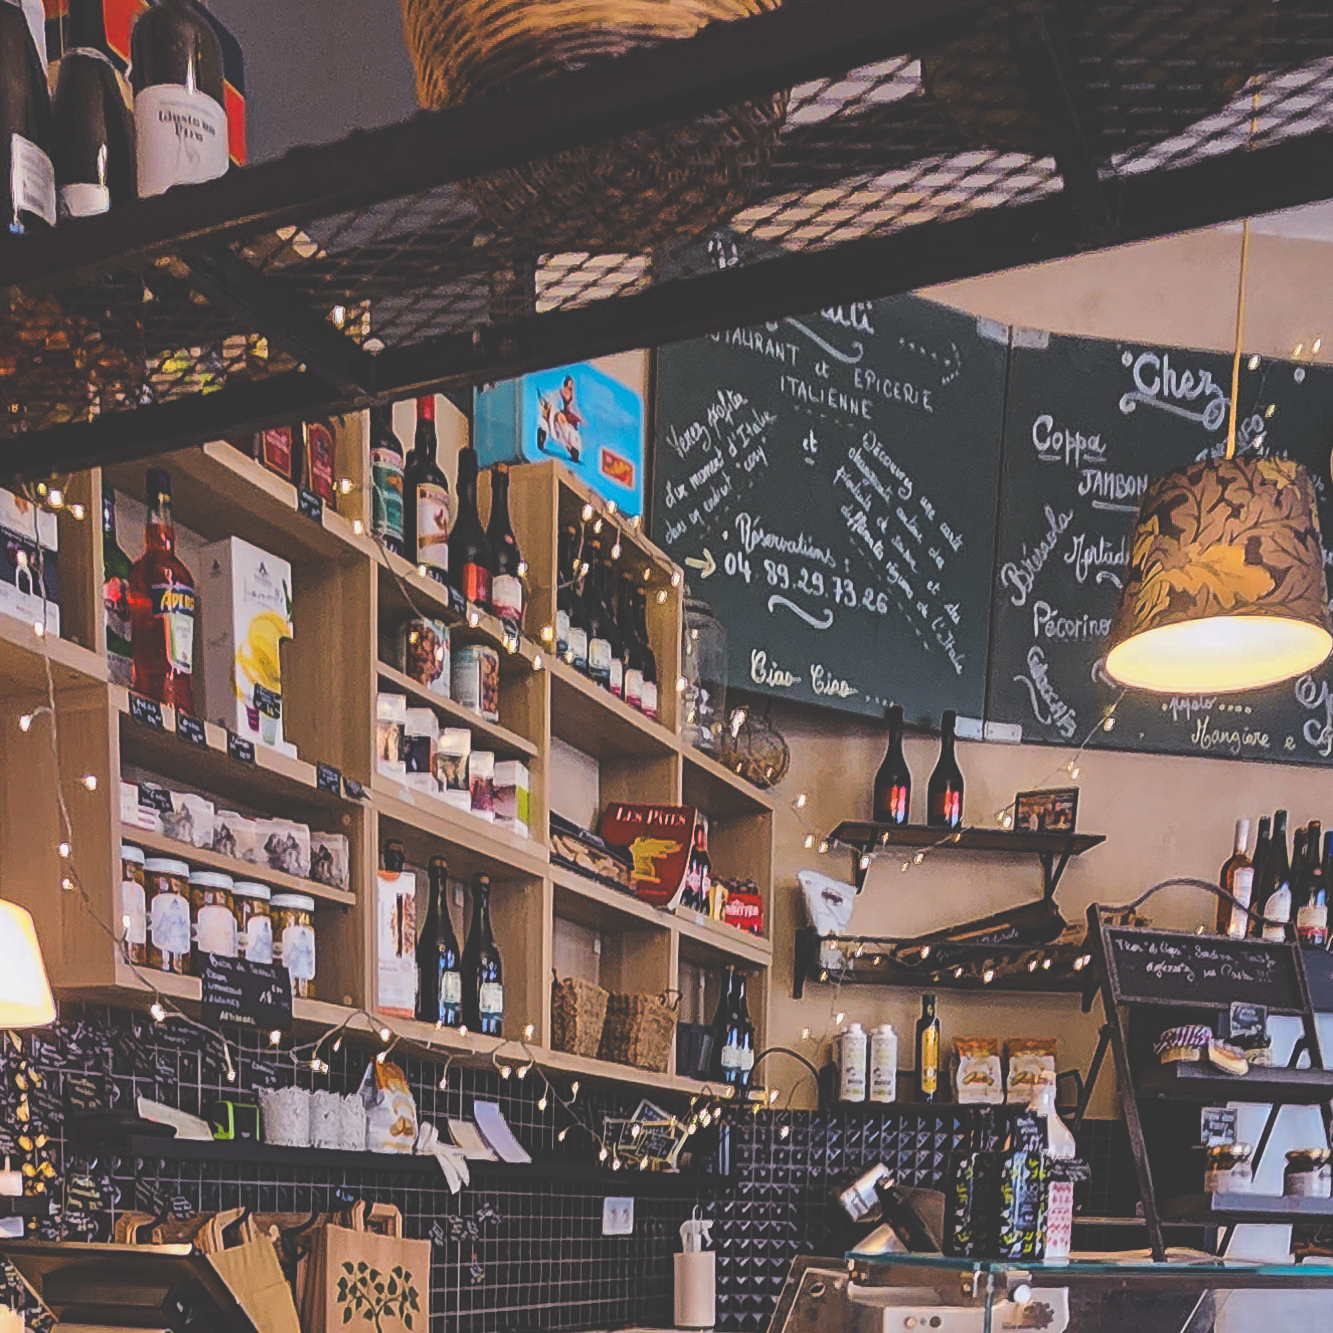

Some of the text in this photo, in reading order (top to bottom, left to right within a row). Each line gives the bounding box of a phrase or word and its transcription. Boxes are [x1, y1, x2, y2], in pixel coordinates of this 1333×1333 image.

[779, 374, 873, 420] ITALIENNE
[854, 367, 934, 414] EPICERIE
[1132, 352, 1229, 412] Chez
[1032, 413, 1107, 468] Coppa
[1078, 468, 1149, 499] JAMBON
[723, 550, 752, 584] 04
[1032, 600, 1113, 638] Pécorino
